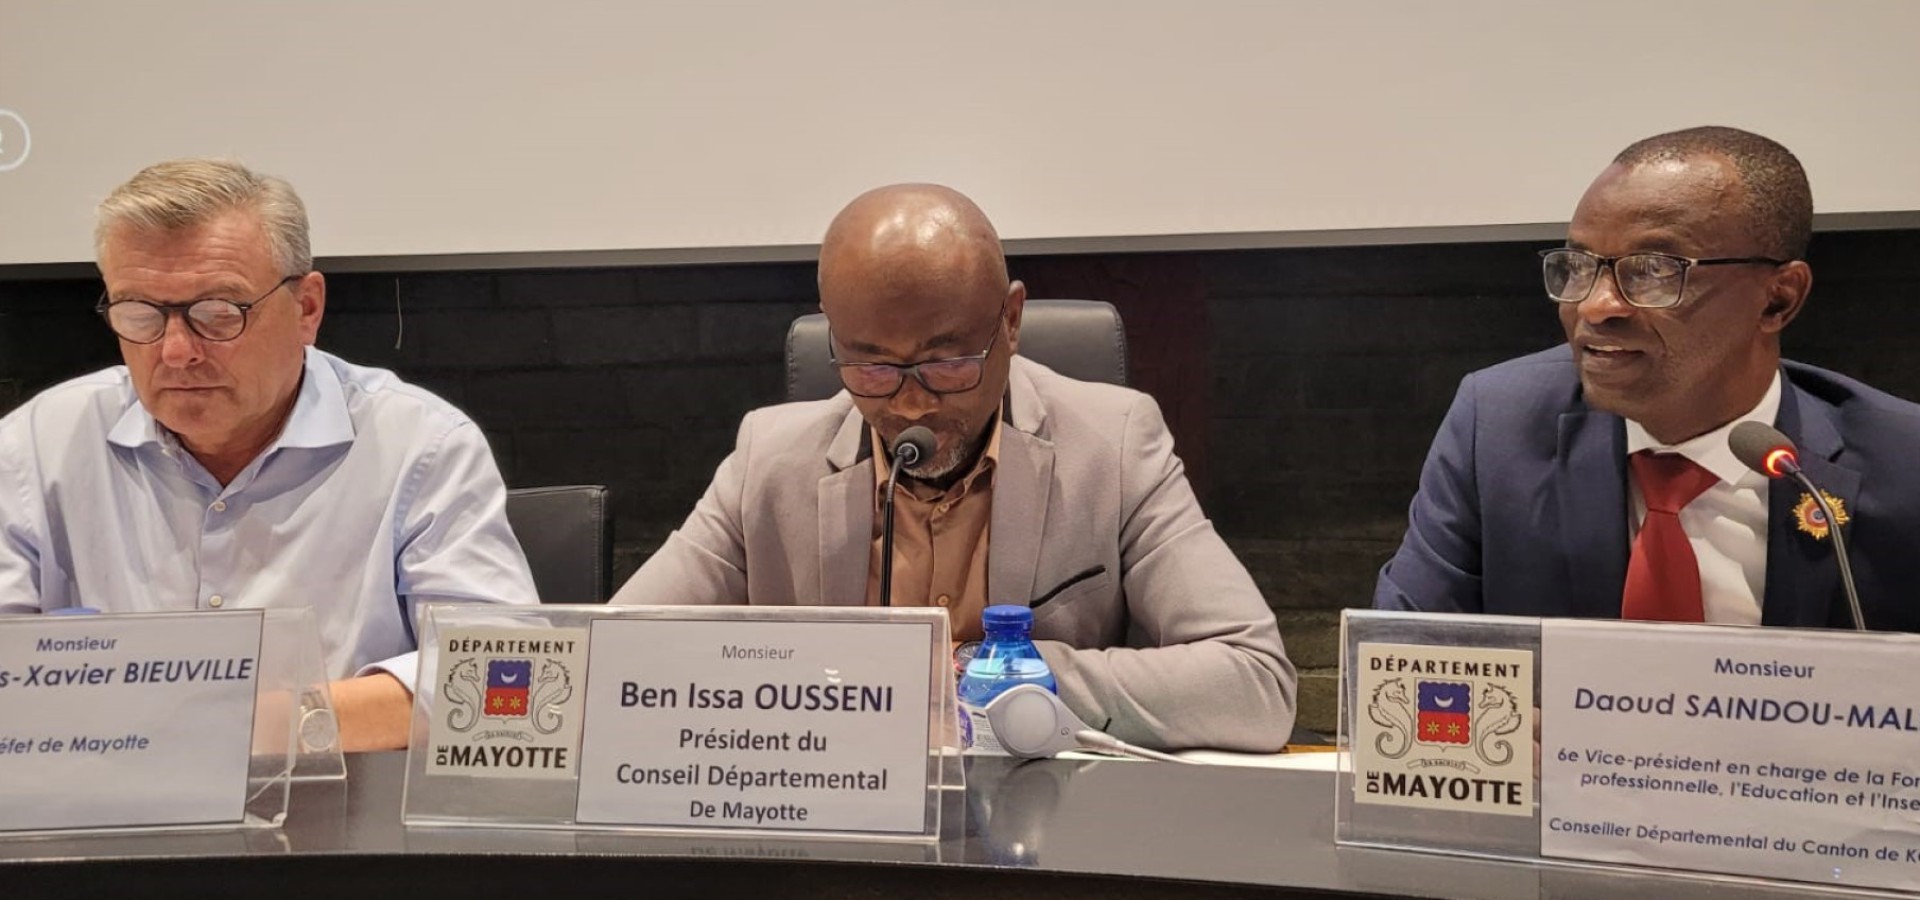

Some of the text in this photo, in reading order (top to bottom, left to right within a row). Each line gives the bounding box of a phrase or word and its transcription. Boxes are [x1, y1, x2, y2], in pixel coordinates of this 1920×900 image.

[36, 637, 117, 652] Monsieur
[449, 637, 575, 654] DÉPARTEMENT
[721, 645, 794, 659] Monsieur
[0, 658, 253, 688] s-Xavier BIEUVILLE
[1370, 654, 1520, 678] DÉPARTEMENT
[1714, 657, 1815, 679] Monsieur
[620, 681, 893, 713] Ben Issa OUSSENI
[1574, 688, 1919, 731] Daoud SAINDOU-MAL
[38, 737, 64, 754] de
[69, 734, 150, 755] Mayotte
[679, 727, 827, 751] Président du
[436, 745, 449, 765] DE
[450, 746, 567, 768] MAYOTTE
[1557, 748, 1579, 762] 6e
[1586, 750, 1721, 773] Vice-président
[1726, 762, 1750, 775] en
[1756, 763, 1827, 783] charge
[1833, 769, 1859, 783] de
[1866, 770, 1884, 786] la
[616, 763, 887, 791] Conseil Départemental
[1367, 771, 1379, 793] DE
[1383, 773, 1522, 805] MAYOTTE
[1730, 782, 1838, 805] l'Education
[1845, 792, 1864, 806] et
[690, 800, 808, 824] De Mayotte
[1549, 817, 1920, 865] Conseiller Départemental du Canton de K
